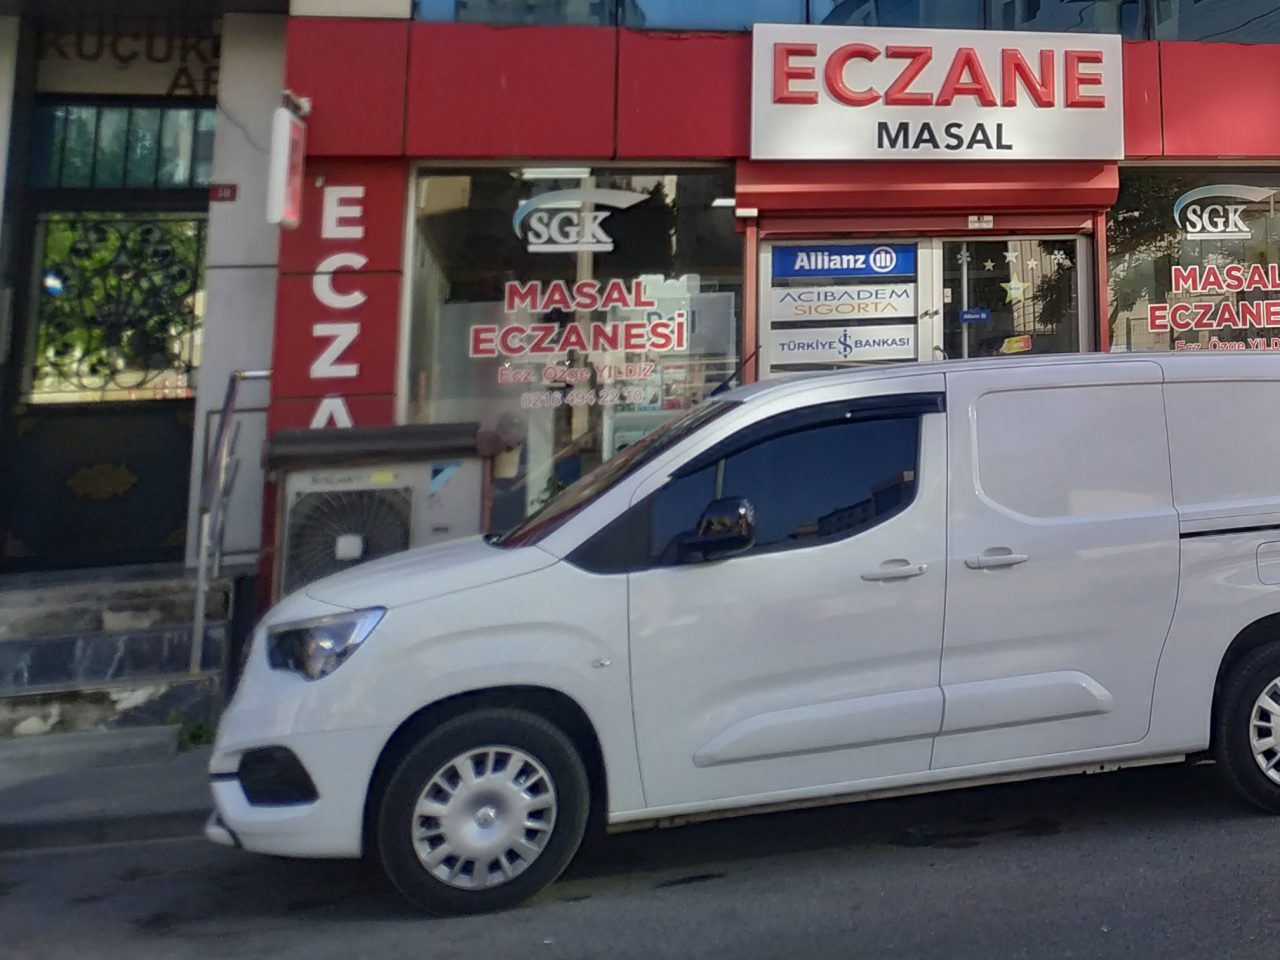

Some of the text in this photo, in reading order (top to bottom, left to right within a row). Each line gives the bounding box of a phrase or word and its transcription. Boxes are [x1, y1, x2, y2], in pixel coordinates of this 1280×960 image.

[772, 41, 1107, 109] ECZANE
[876, 121, 1014, 151] MASAL
[527, 211, 614, 243] SGK
[1186, 204, 1250, 233] SGK
[794, 251, 867, 271] Allianz
[504, 279, 657, 313] MASAL
[779, 288, 910, 303] ACIBADEM
[469, 310, 687, 357] ECZANESİ
[779, 340, 837, 352] TÜRKİYE
[855, 337, 910, 349] BANKASI
[543, 361, 590, 383] Özge
[595, 363, 655, 379] YILDIZ
